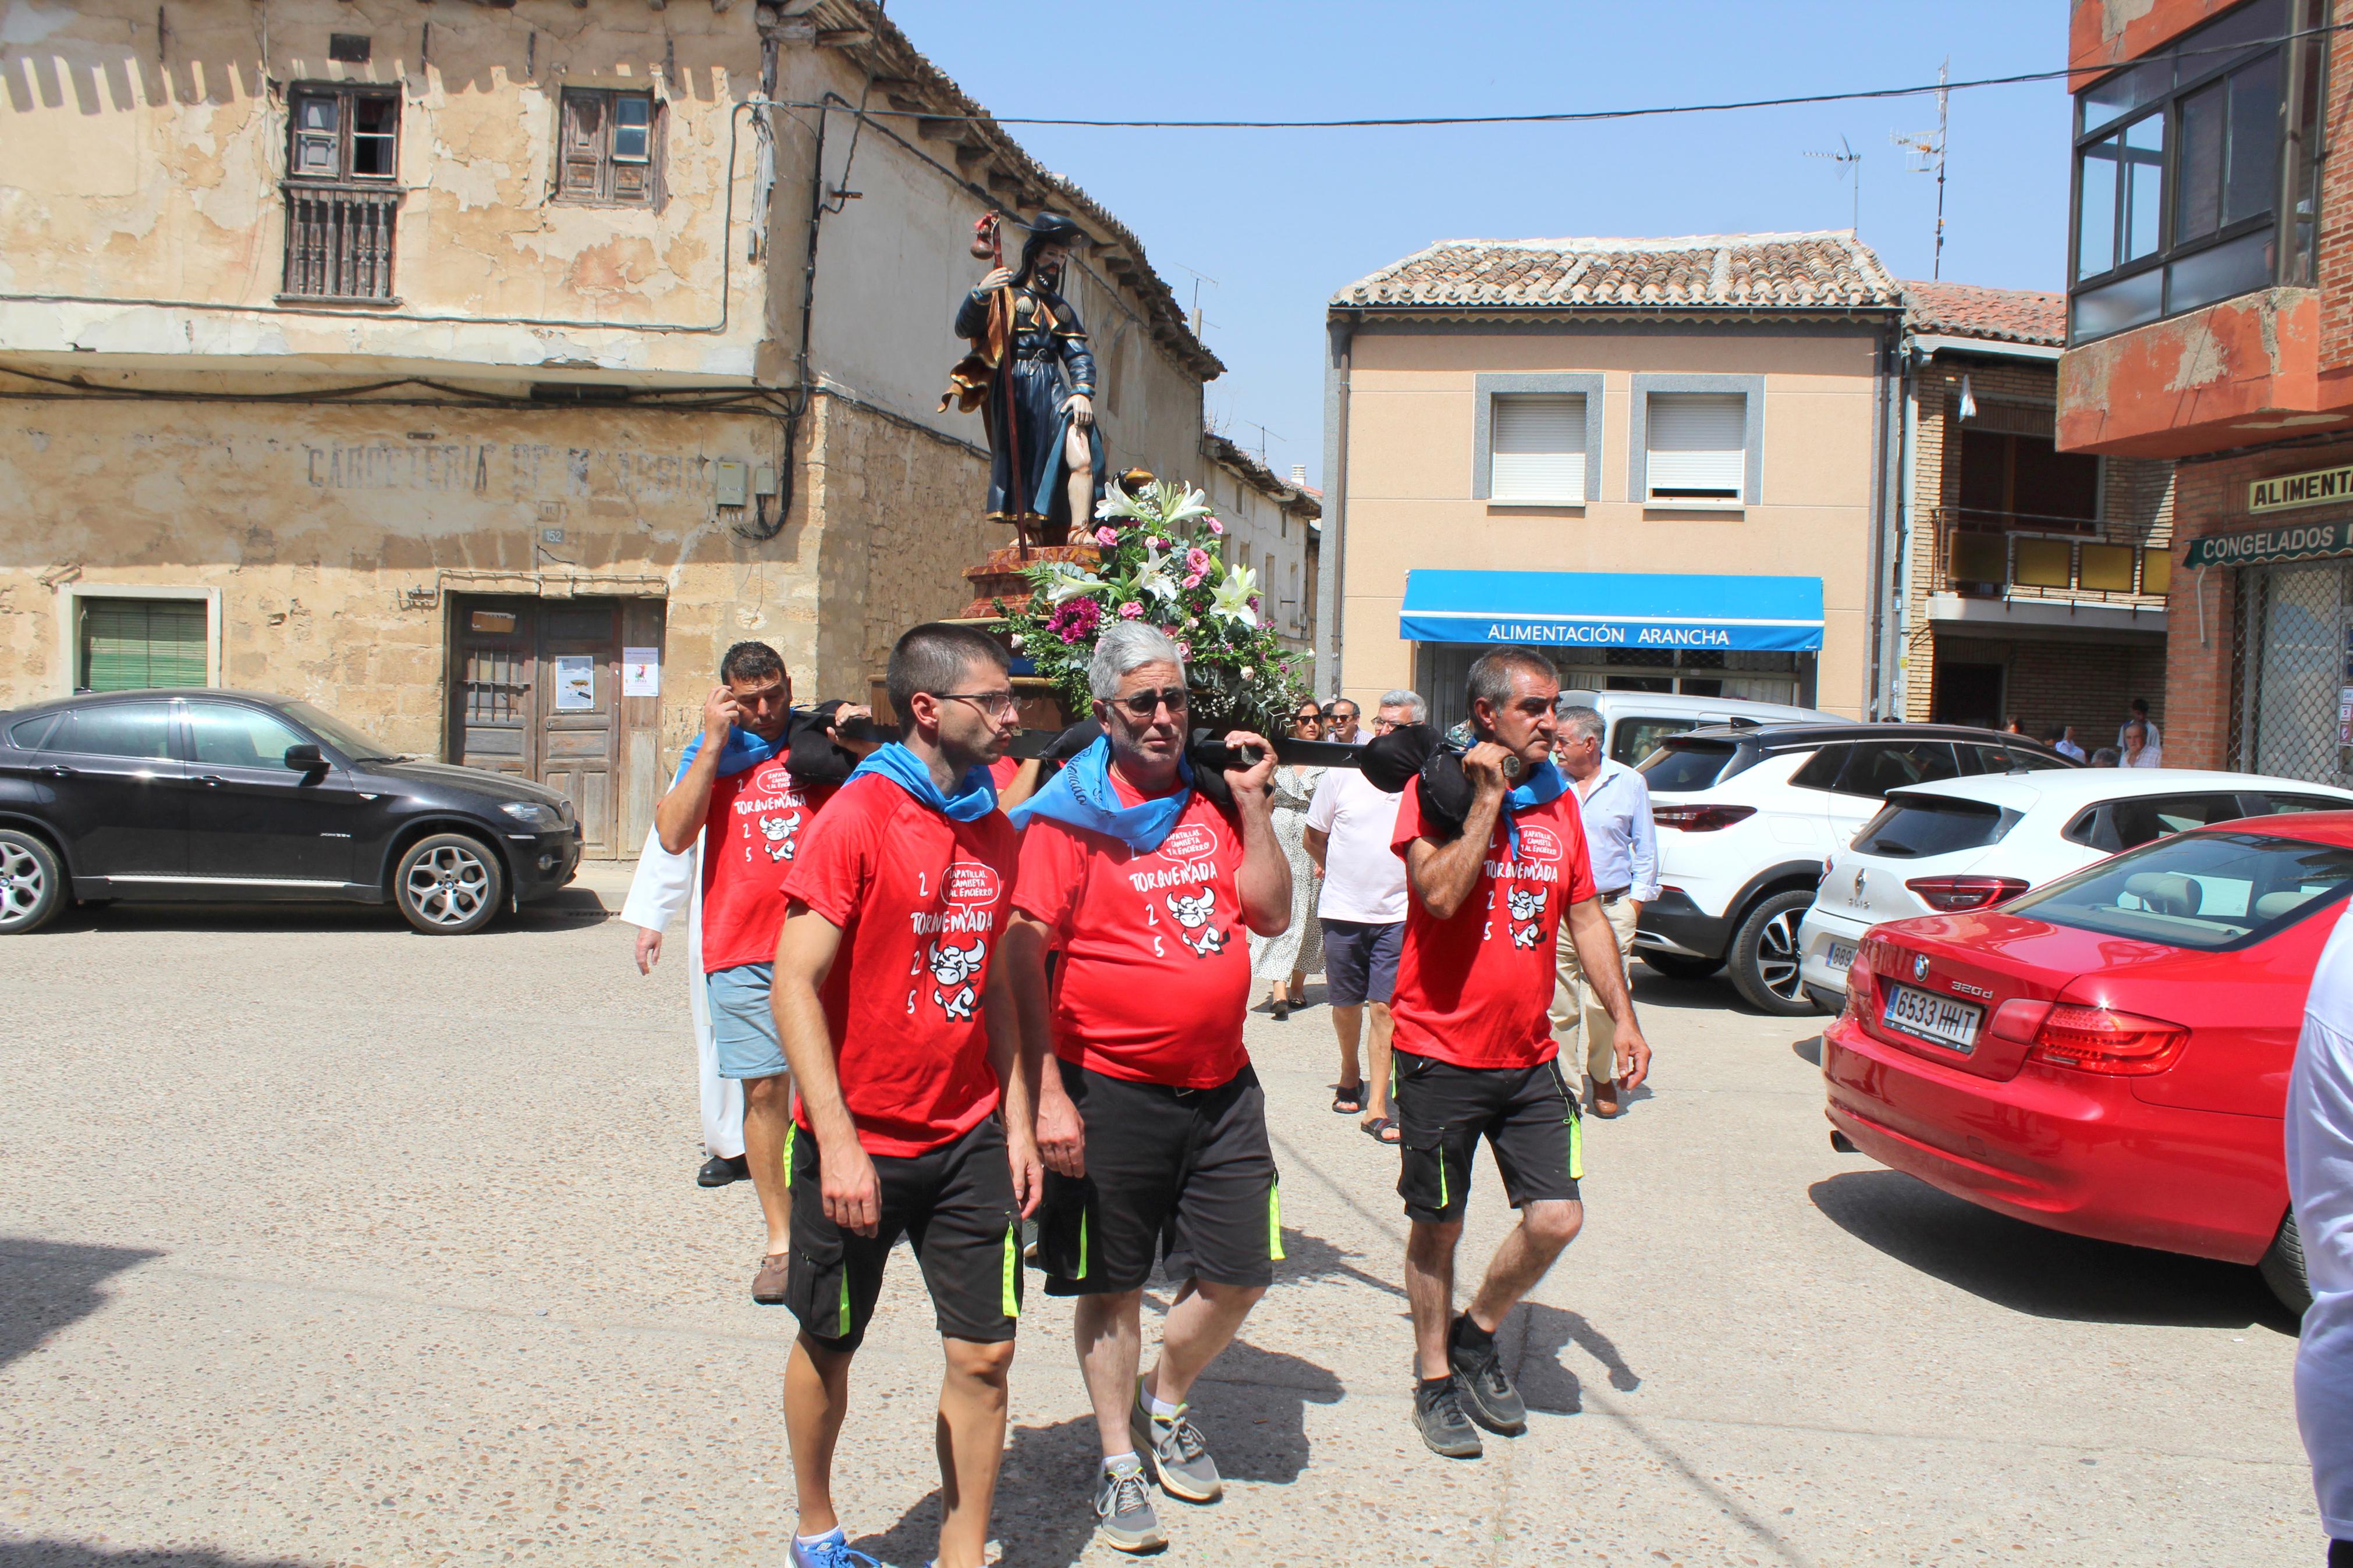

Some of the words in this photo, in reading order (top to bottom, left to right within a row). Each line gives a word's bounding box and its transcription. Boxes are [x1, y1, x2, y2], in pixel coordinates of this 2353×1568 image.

[2253, 470, 2353, 506] ALIMENT
[546, 531, 562, 542] 152
[2203, 525, 2335, 559] CONGELADOS
[1488, 624, 1624, 643] ALIMENTACIÓN
[1638, 628, 1730, 646] ARANCHA
[737, 779, 746, 792] 2
[734, 794, 806, 815] TORQUEMADA
[743, 823, 751, 838] 2
[1166, 848, 1172, 856] Y
[1171, 837, 1200, 848] CAMISETA
[1527, 838, 1551, 847] CAMISETA
[746, 847, 752, 862] 5
[1129, 861, 1218, 893] TORQUEMADA
[1484, 859, 1558, 883] TORQUEMADA
[918, 872, 929, 897] 2
[951, 879, 985, 888] CAMISETA
[1487, 890, 1496, 909] 2
[1145, 904, 1159, 926] 2
[1484, 921, 1493, 940] 5
[1154, 936, 1165, 958] 5
[1833, 947, 1852, 968] 889
[911, 951, 920, 975] 2
[1951, 980, 1994, 1000] 320d
[907, 990, 917, 1014] 5
[1897, 991, 1937, 1027] 6533
[1936, 1004, 1975, 1039] HHT
